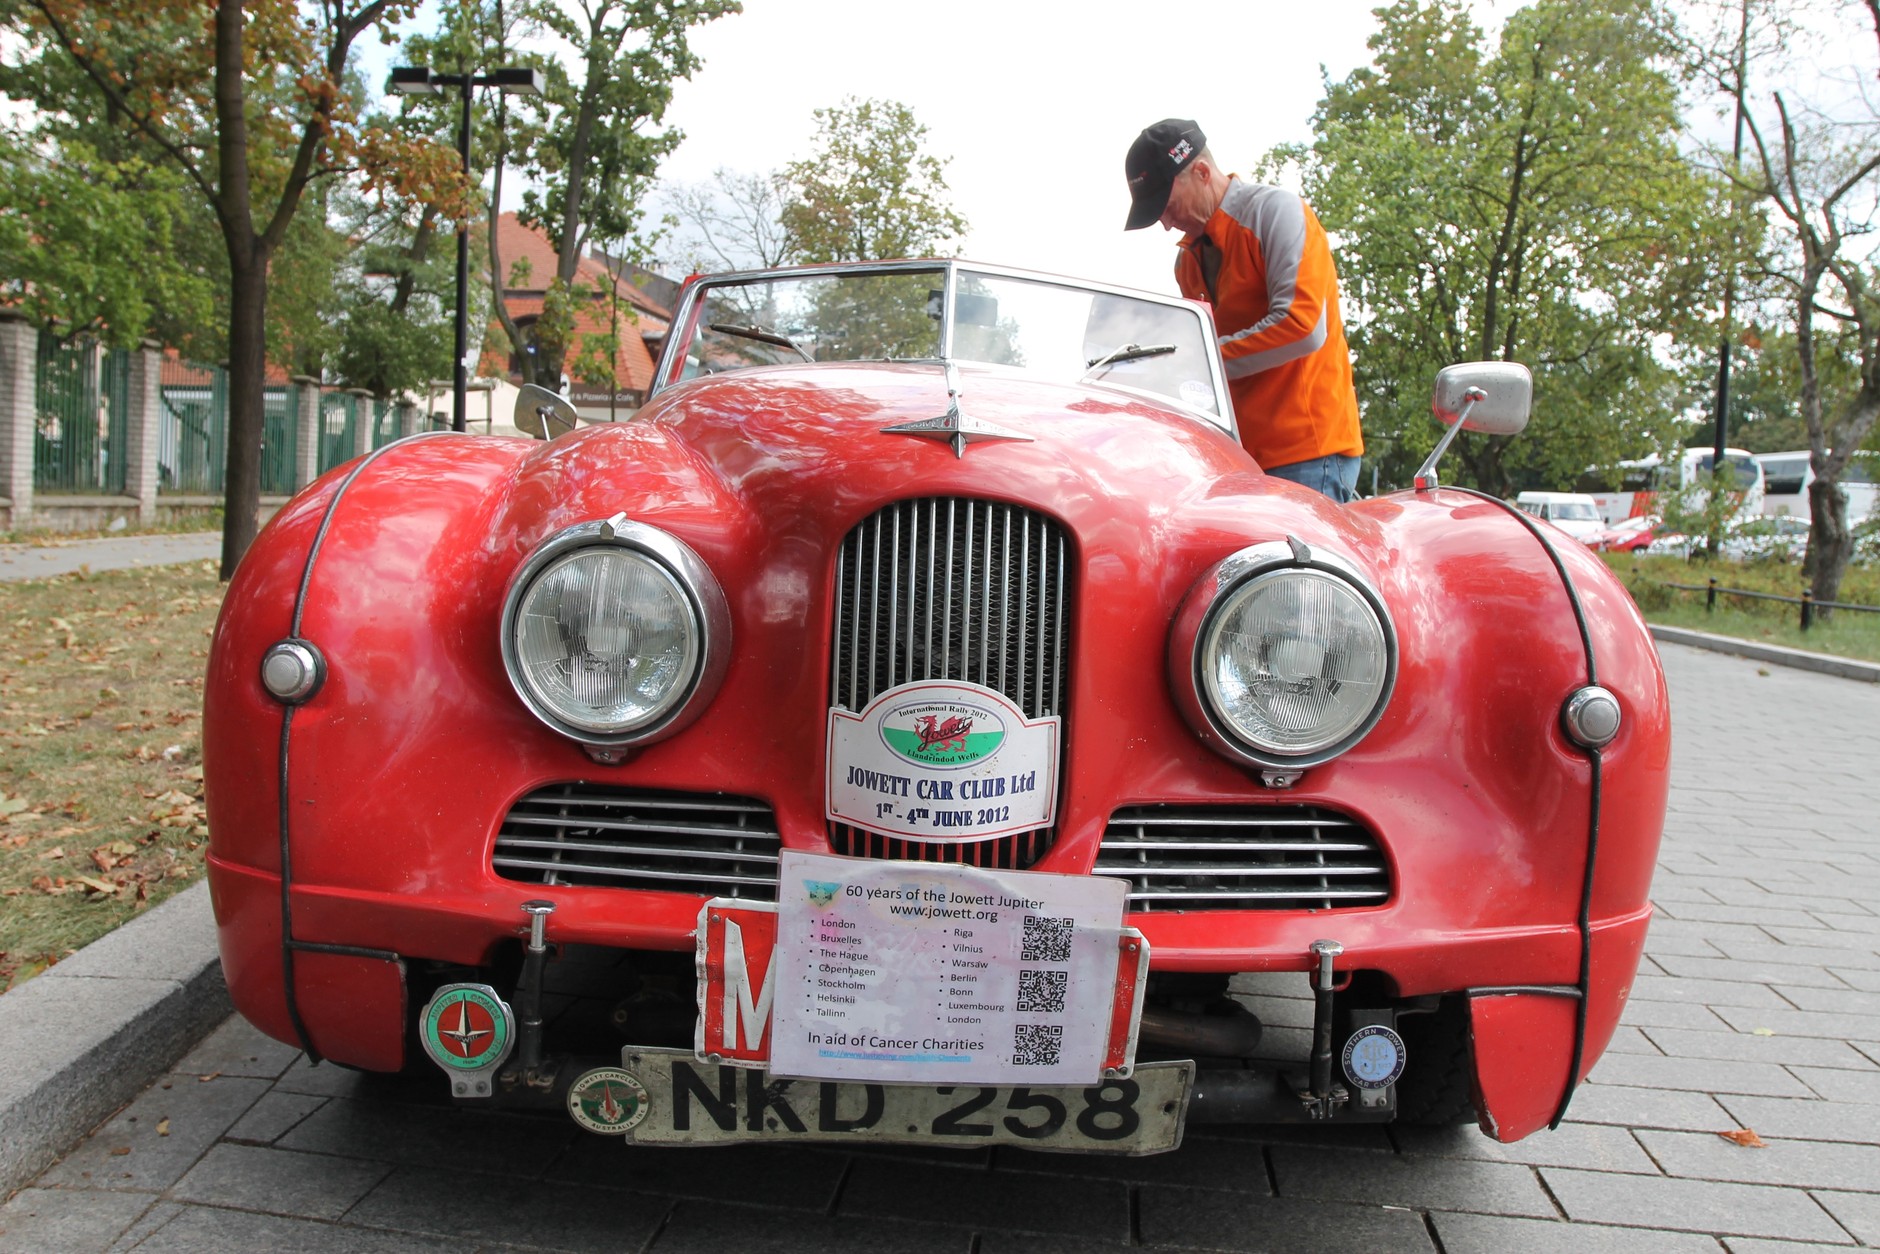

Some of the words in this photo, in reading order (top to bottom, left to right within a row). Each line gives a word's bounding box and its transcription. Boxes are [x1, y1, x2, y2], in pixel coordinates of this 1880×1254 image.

[899, 705, 947, 717] International
[949, 706, 968, 714] Rally
[971, 709, 988, 720] 2012
[917, 716, 973, 752] Jowett
[907, 749, 955, 762] Llandrindod
[958, 752, 979, 761] Wells
[847, 765, 910, 797] JOWETT
[916, 779, 954, 800] CAR
[960, 777, 1005, 799] CLUB
[1011, 771, 1036, 795] Ltd
[933, 810, 973, 826] JUNE
[977, 805, 1010, 825] 2012
[846, 885, 863, 897] 60
[866, 888, 902, 899] years
[906, 888, 920, 900] of
[923, 890, 946, 902] the
[949, 892, 994, 906] Jowett
[998, 895, 1045, 910] Jupiter
[890, 905, 998, 923] www.jowett.org
[821, 919, 856, 929] London
[954, 928, 973, 939] Riga
[820, 934, 862, 945] Bruxelles
[952, 944, 983, 954] Vilnius
[820, 949, 837, 958] The
[839, 951, 869, 961] Hague
[952, 959, 989, 969] Warsaw
[818, 964, 876, 976] Copenhagen
[950, 974, 977, 983] Berlin
[818, 979, 866, 990] Stockholm
[949, 988, 973, 996] Bonn
[817, 994, 856, 1004] Helsinkii
[948, 1002, 1005, 1012] Luxembourg
[816, 1008, 846, 1018] Tallinn
[947, 1016, 981, 1024] London
[808, 1032, 821, 1044] In
[825, 1033, 846, 1046] aid
[851, 1034, 866, 1047] of
[869, 1037, 918, 1049] Cancer
[922, 1038, 984, 1050] Charities
[1345, 1028, 1377, 1065] SOUTHERN
[1384, 1032, 1404, 1063] JOWETT
[1353, 1076, 1369, 1087] CAR
[1373, 1074, 1395, 1088] CLUB
[671, 1060, 885, 1133] NKD
[931, 1078, 1140, 1141] 258
[591, 1121, 635, 1131] AUSTRALIA
